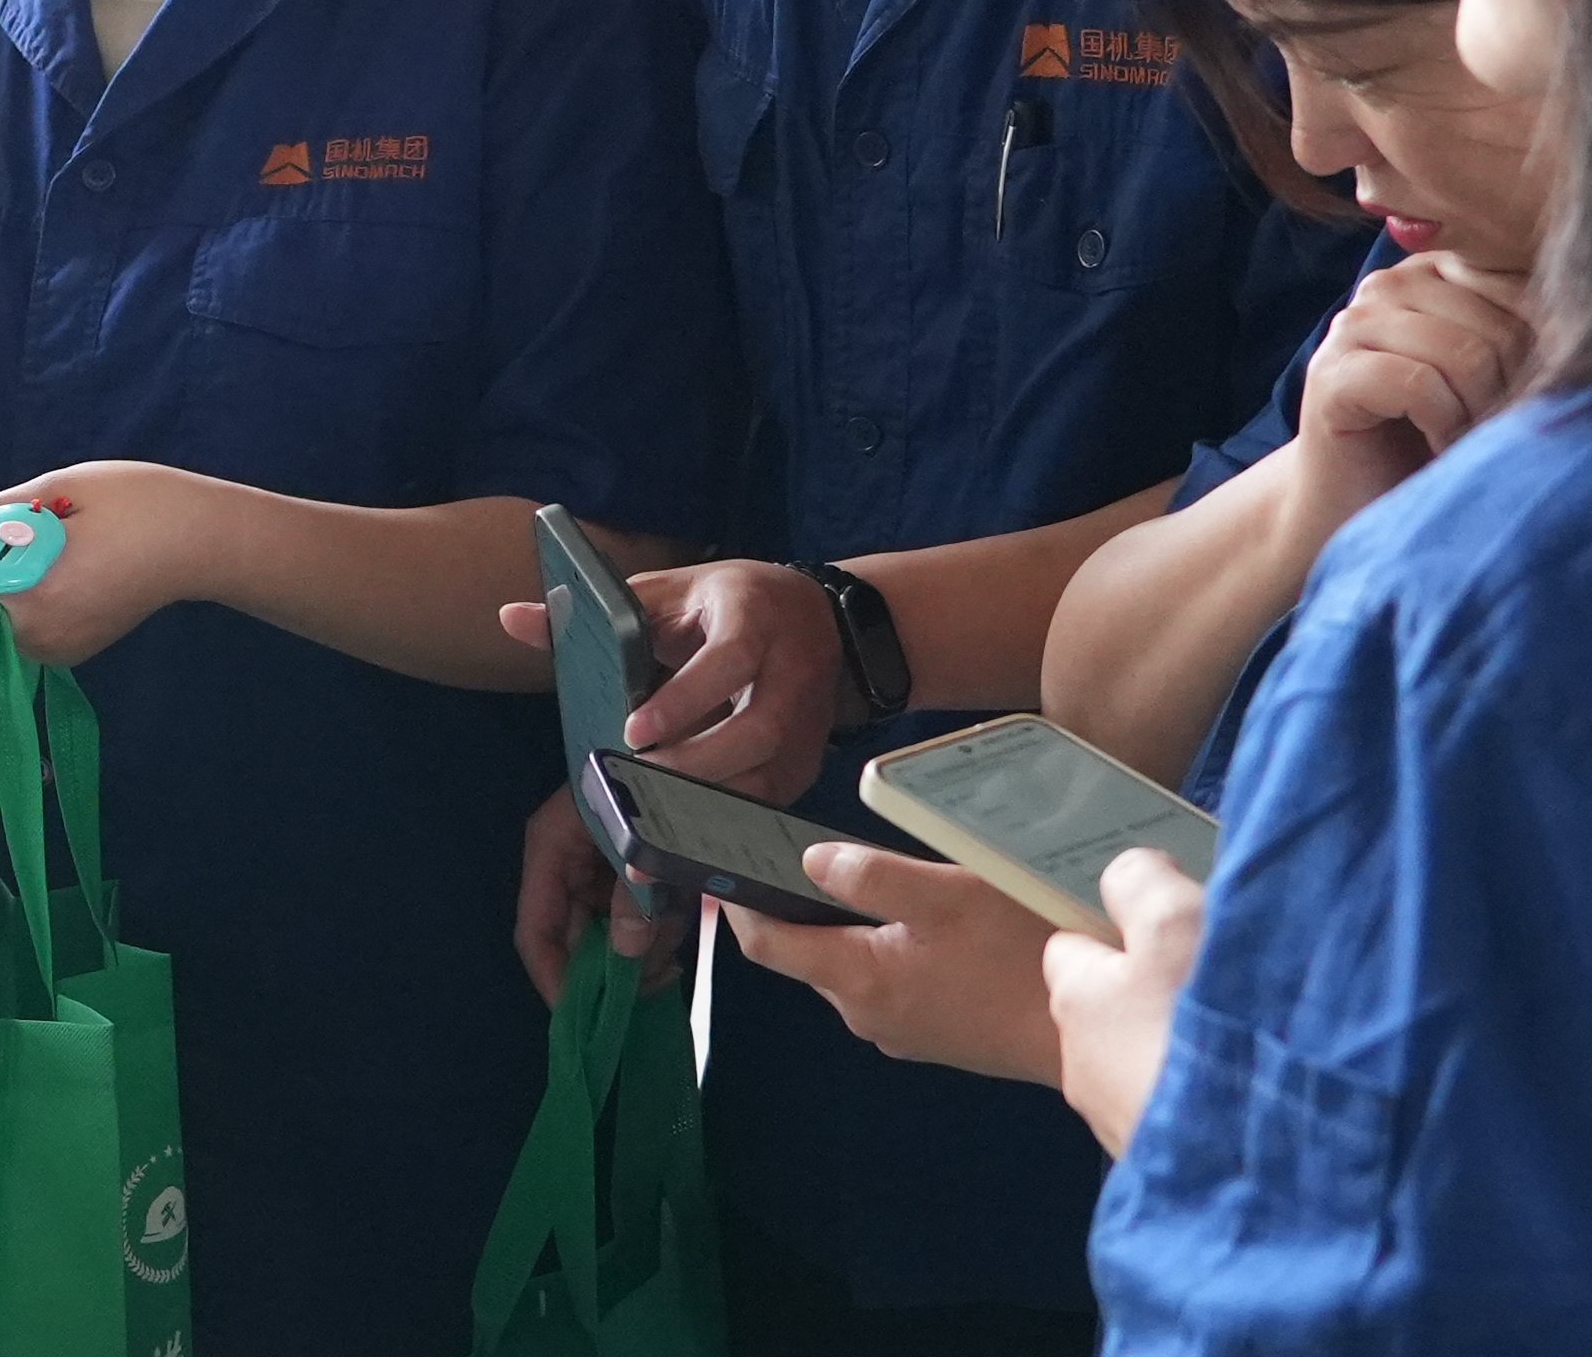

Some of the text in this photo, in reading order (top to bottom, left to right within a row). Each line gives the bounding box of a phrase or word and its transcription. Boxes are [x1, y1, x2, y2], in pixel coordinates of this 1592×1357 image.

[324, 135, 429, 163] 国机集团
[322, 164, 426, 180] SINOMACH
